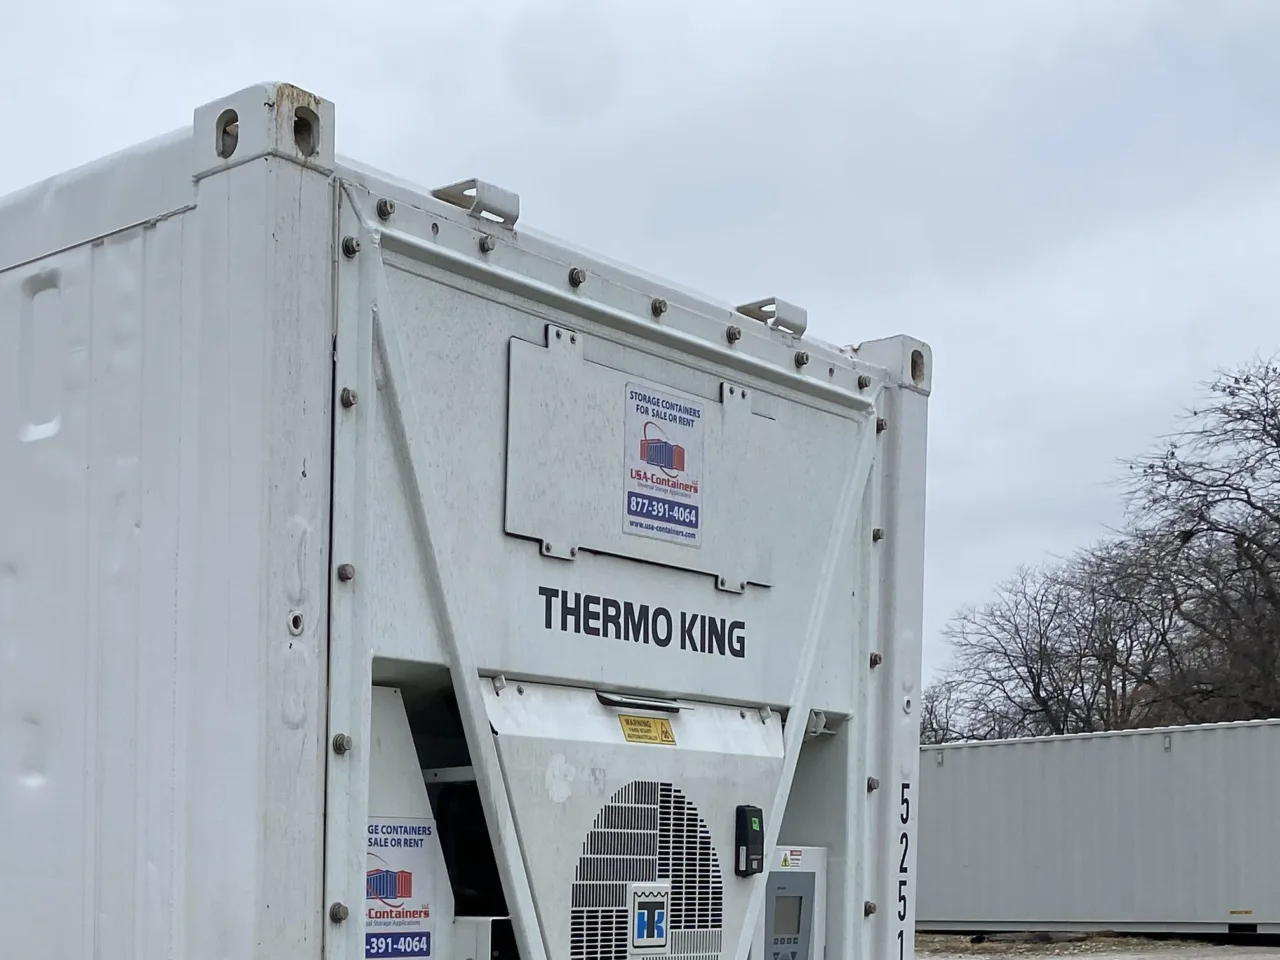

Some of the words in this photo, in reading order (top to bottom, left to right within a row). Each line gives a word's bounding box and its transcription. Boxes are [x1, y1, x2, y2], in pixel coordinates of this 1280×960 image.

[630, 391, 660, 407] STORAGE
[661, 400, 700, 419] CONTAINERS
[636, 404, 649, 415] FOR
[651, 409, 667, 421] SALE
[668, 413, 678, 424] OR
[678, 416, 695, 428] RENT
[630, 468, 699, 494] USA-Containers
[630, 496, 696, 524] 877-391-4064
[629, 520, 696, 540] www.usa-containers.com
[538, 585, 673, 648] THERMO
[680, 611, 746, 658] KING
[380, 824, 432, 836] CONTAINERS
[368, 837, 389, 847] SALE
[390, 838, 402, 848] OR
[403, 838, 424, 848] RENT
[365, 936, 427, 954] -391-4064
